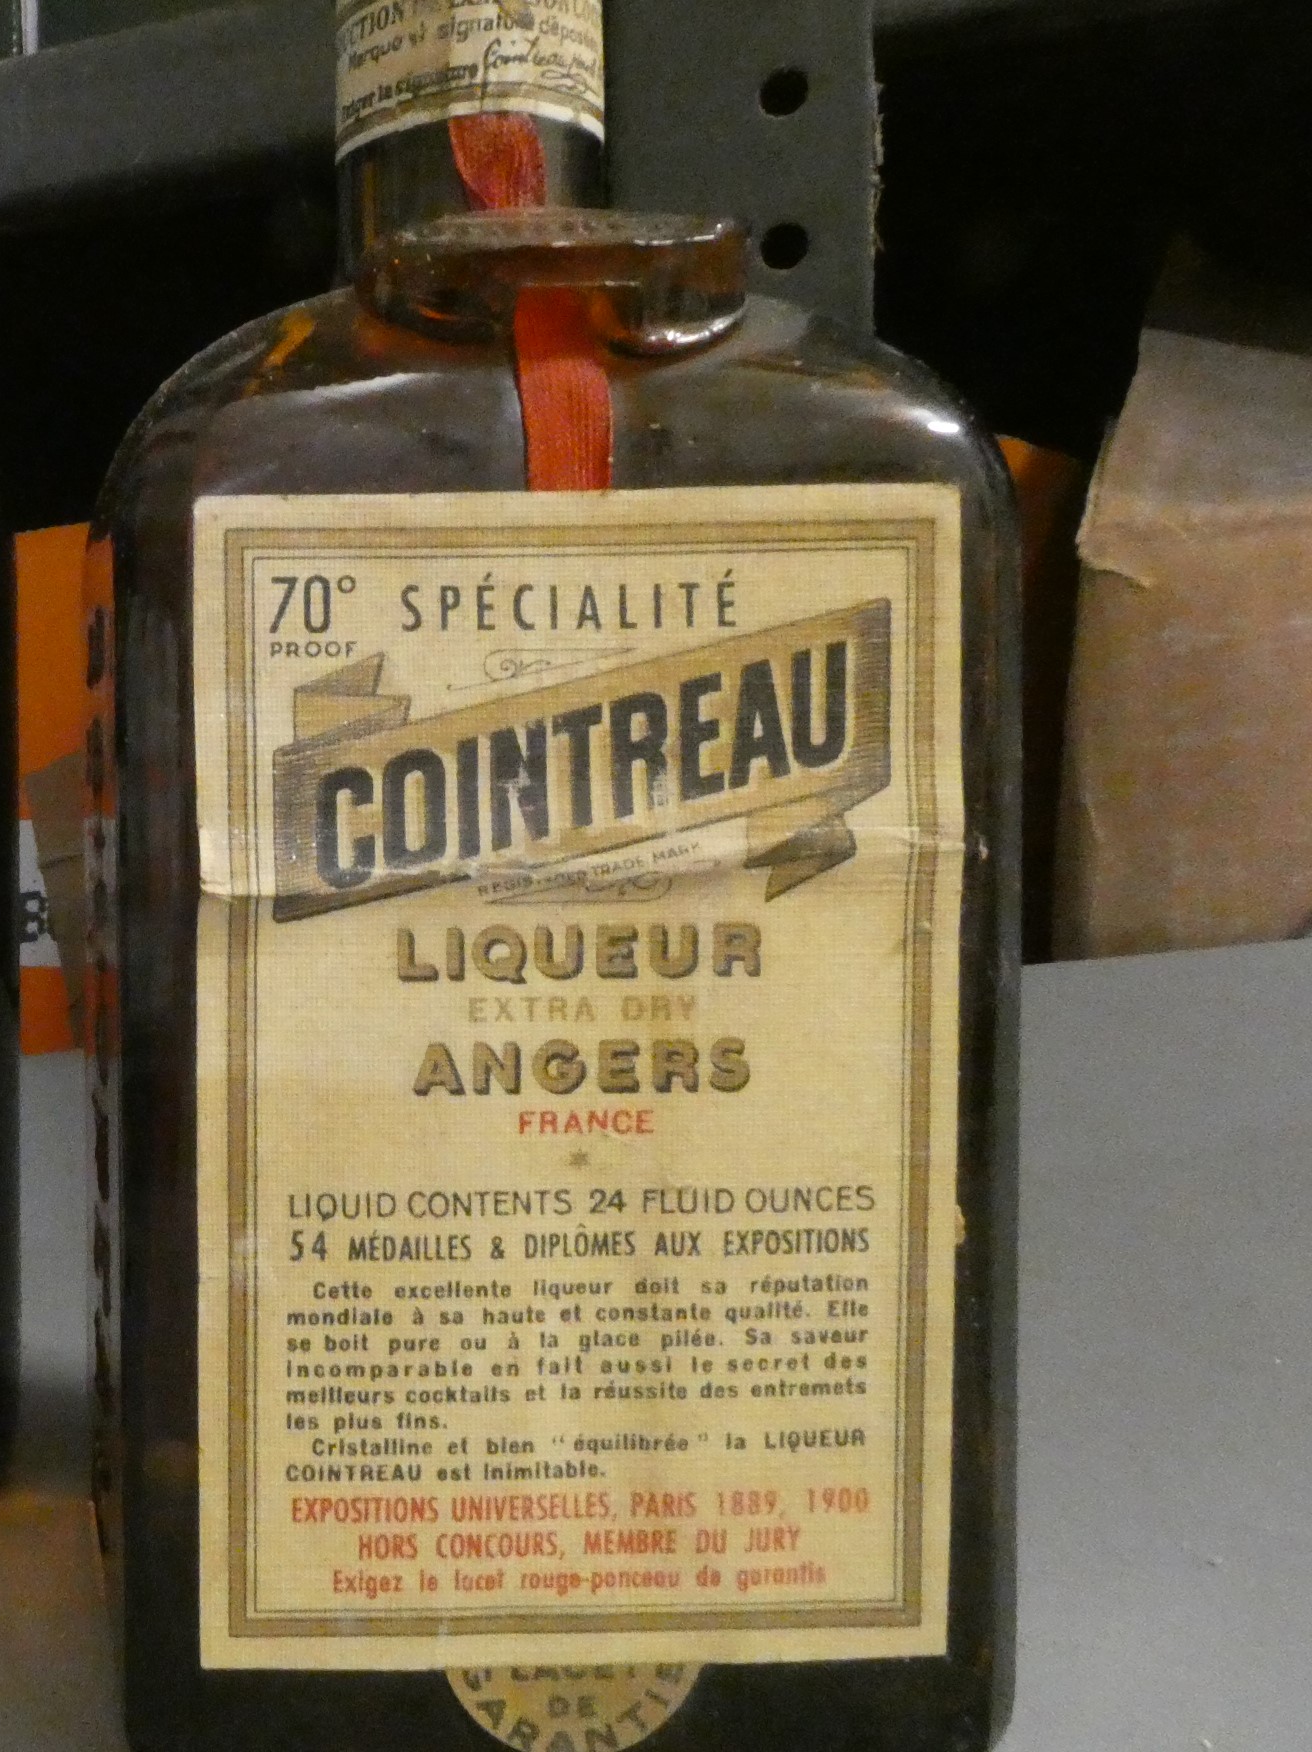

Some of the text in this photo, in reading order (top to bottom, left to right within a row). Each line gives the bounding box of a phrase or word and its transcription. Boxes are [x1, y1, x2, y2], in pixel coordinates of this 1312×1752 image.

[269, 569, 737, 634] 70° SPÉCIALITÉ
[270, 642, 358, 659] PROOF
[315, 642, 849, 891] COINTREAU
[591, 856, 644, 876] TRADE
[652, 842, 700, 863] MARK
[396, 921, 762, 984] LIQUEUR
[468, 996, 698, 1023] EXTRA DRY
[413, 1038, 751, 1097] ANGERS
[518, 1110, 655, 1135] FRANCE
[288, 1185, 875, 1222] LIQUID CONTENTS 24 FLUID OUNCES
[290, 1223, 870, 1261] 54 MÉDAILLES & DIPLÔMES AUX EXPOSITIONS
[313, 1274, 869, 1300] Cette excellente liqueur doit sa réputation
[287, 1299, 869, 1326] mondiale à sa haute et constante qualité. Elle
[287, 1328, 869, 1356] se boit pure ou à la glace pilée. Sa saveur
[491, 1361, 520, 1377] en
[537, 1355, 582, 1376] fait
[600, 1355, 672, 1374] aussi
[692, 1355, 713, 1374] le
[727, 1353, 810, 1373] secret
[825, 1352, 868, 1370] des
[287, 1376, 867, 1404] meilleurs cocktails et la réussite des entremets
[287, 1412, 448, 1434] les plus fins.
[312, 1438, 433, 1457] Cristalline
[448, 1437, 468, 1455] et
[487, 1437, 534, 1455] bien
[726, 1431, 747, 1450] la
[764, 1427, 866, 1452] LIQUEUR
[286, 1464, 422, 1482] COINTREAU
[438, 1463, 471, 1481] est
[292, 1487, 869, 1523] EXPOSITIONS UNIVERSELLES, PARIS 1889, 1900
[358, 1525, 801, 1560] HORS CONCOURS, MEMBRE DU JURY
[333, 1569, 403, 1600] Exigez
[420, 1569, 438, 1592] le
[521, 1570, 680, 1596] rouge-ponceau
[696, 1565, 721, 1587] de
[549, 1694, 595, 1719] DE
